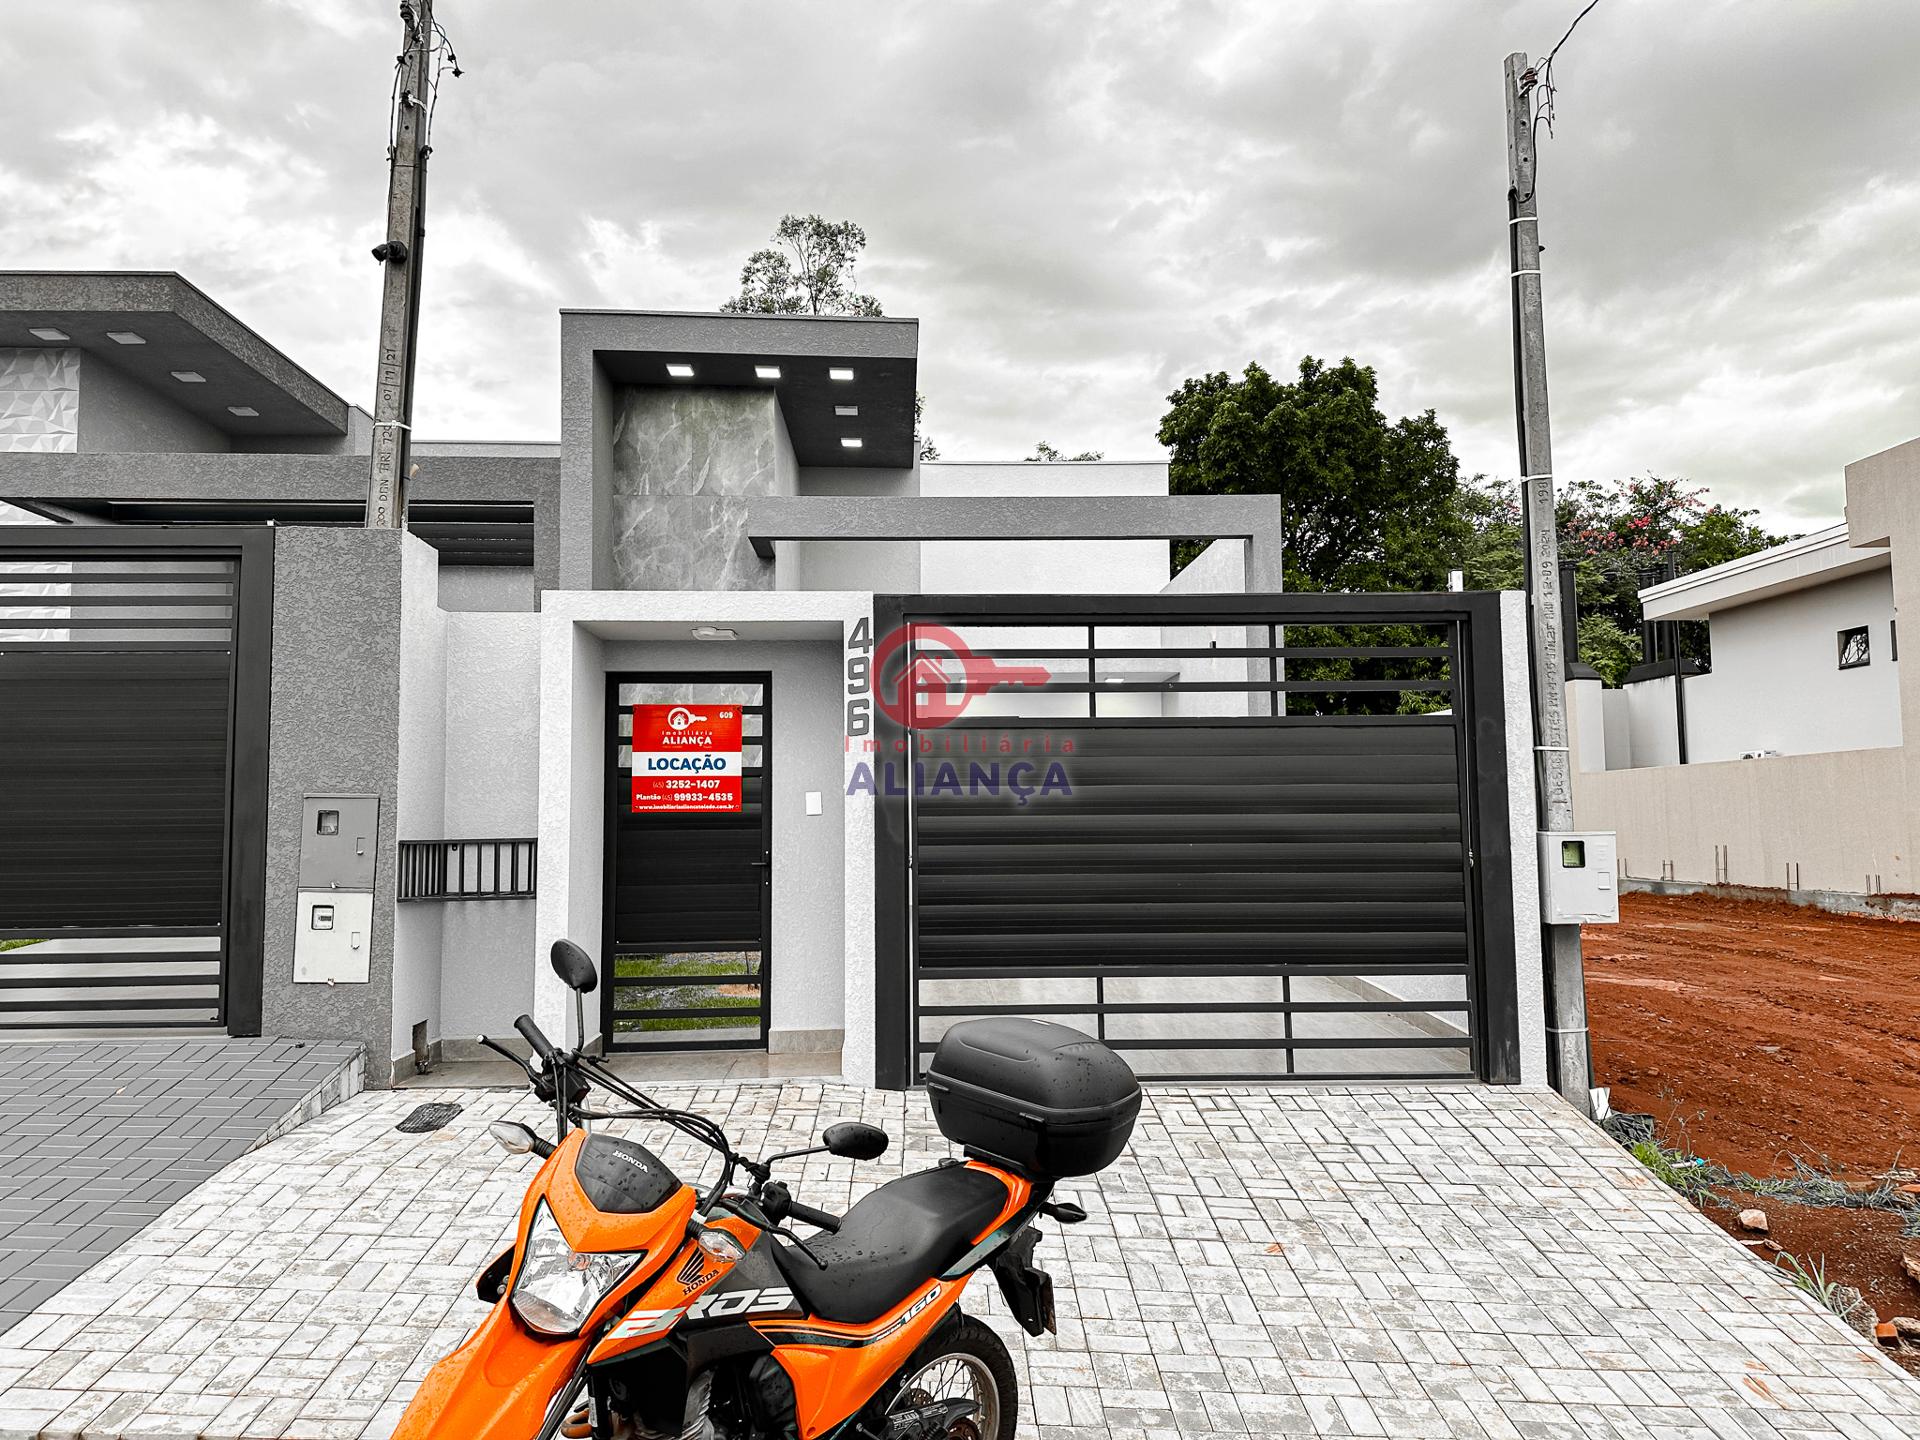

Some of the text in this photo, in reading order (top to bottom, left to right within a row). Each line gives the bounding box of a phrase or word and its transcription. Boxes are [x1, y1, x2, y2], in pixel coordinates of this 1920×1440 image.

[385, 348, 396, 361] 21
[383, 389, 393, 401] 01
[847, 616, 873, 737] 496
[719, 711, 734, 719] 609
[662, 736, 712, 746] ALIANÇA
[647, 754, 727, 774] LOCAÇÃO
[666, 780, 720, 789] 3252-1407
[674, 792, 733, 801] 99933-4535
[612, 1149, 648, 1173] HONDA
[682, 1269, 719, 1296] HONDA
[901, 1284, 942, 1324] 160
